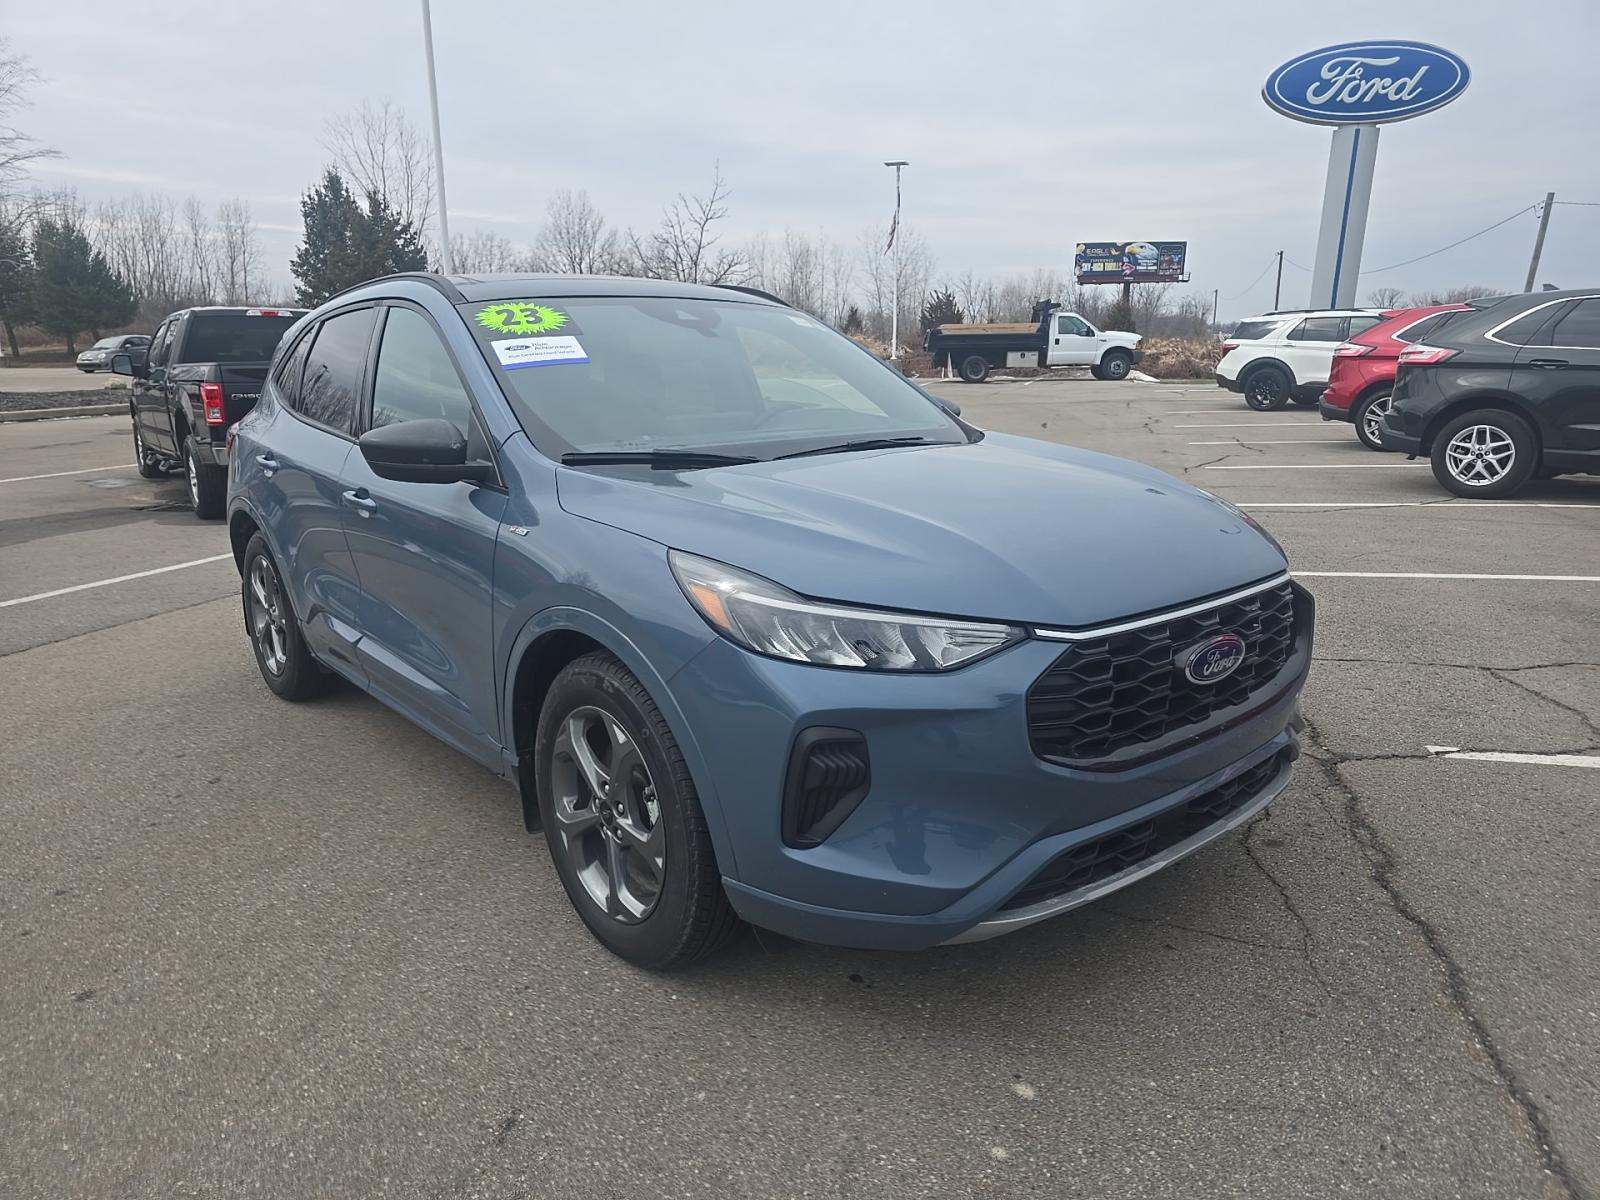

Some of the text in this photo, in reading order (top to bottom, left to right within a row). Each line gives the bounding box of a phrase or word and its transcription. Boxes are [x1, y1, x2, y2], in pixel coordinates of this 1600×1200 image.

[1306, 56, 1430, 105] Ford
[495, 308, 543, 327] 23
[1203, 646, 1235, 676] Ford
